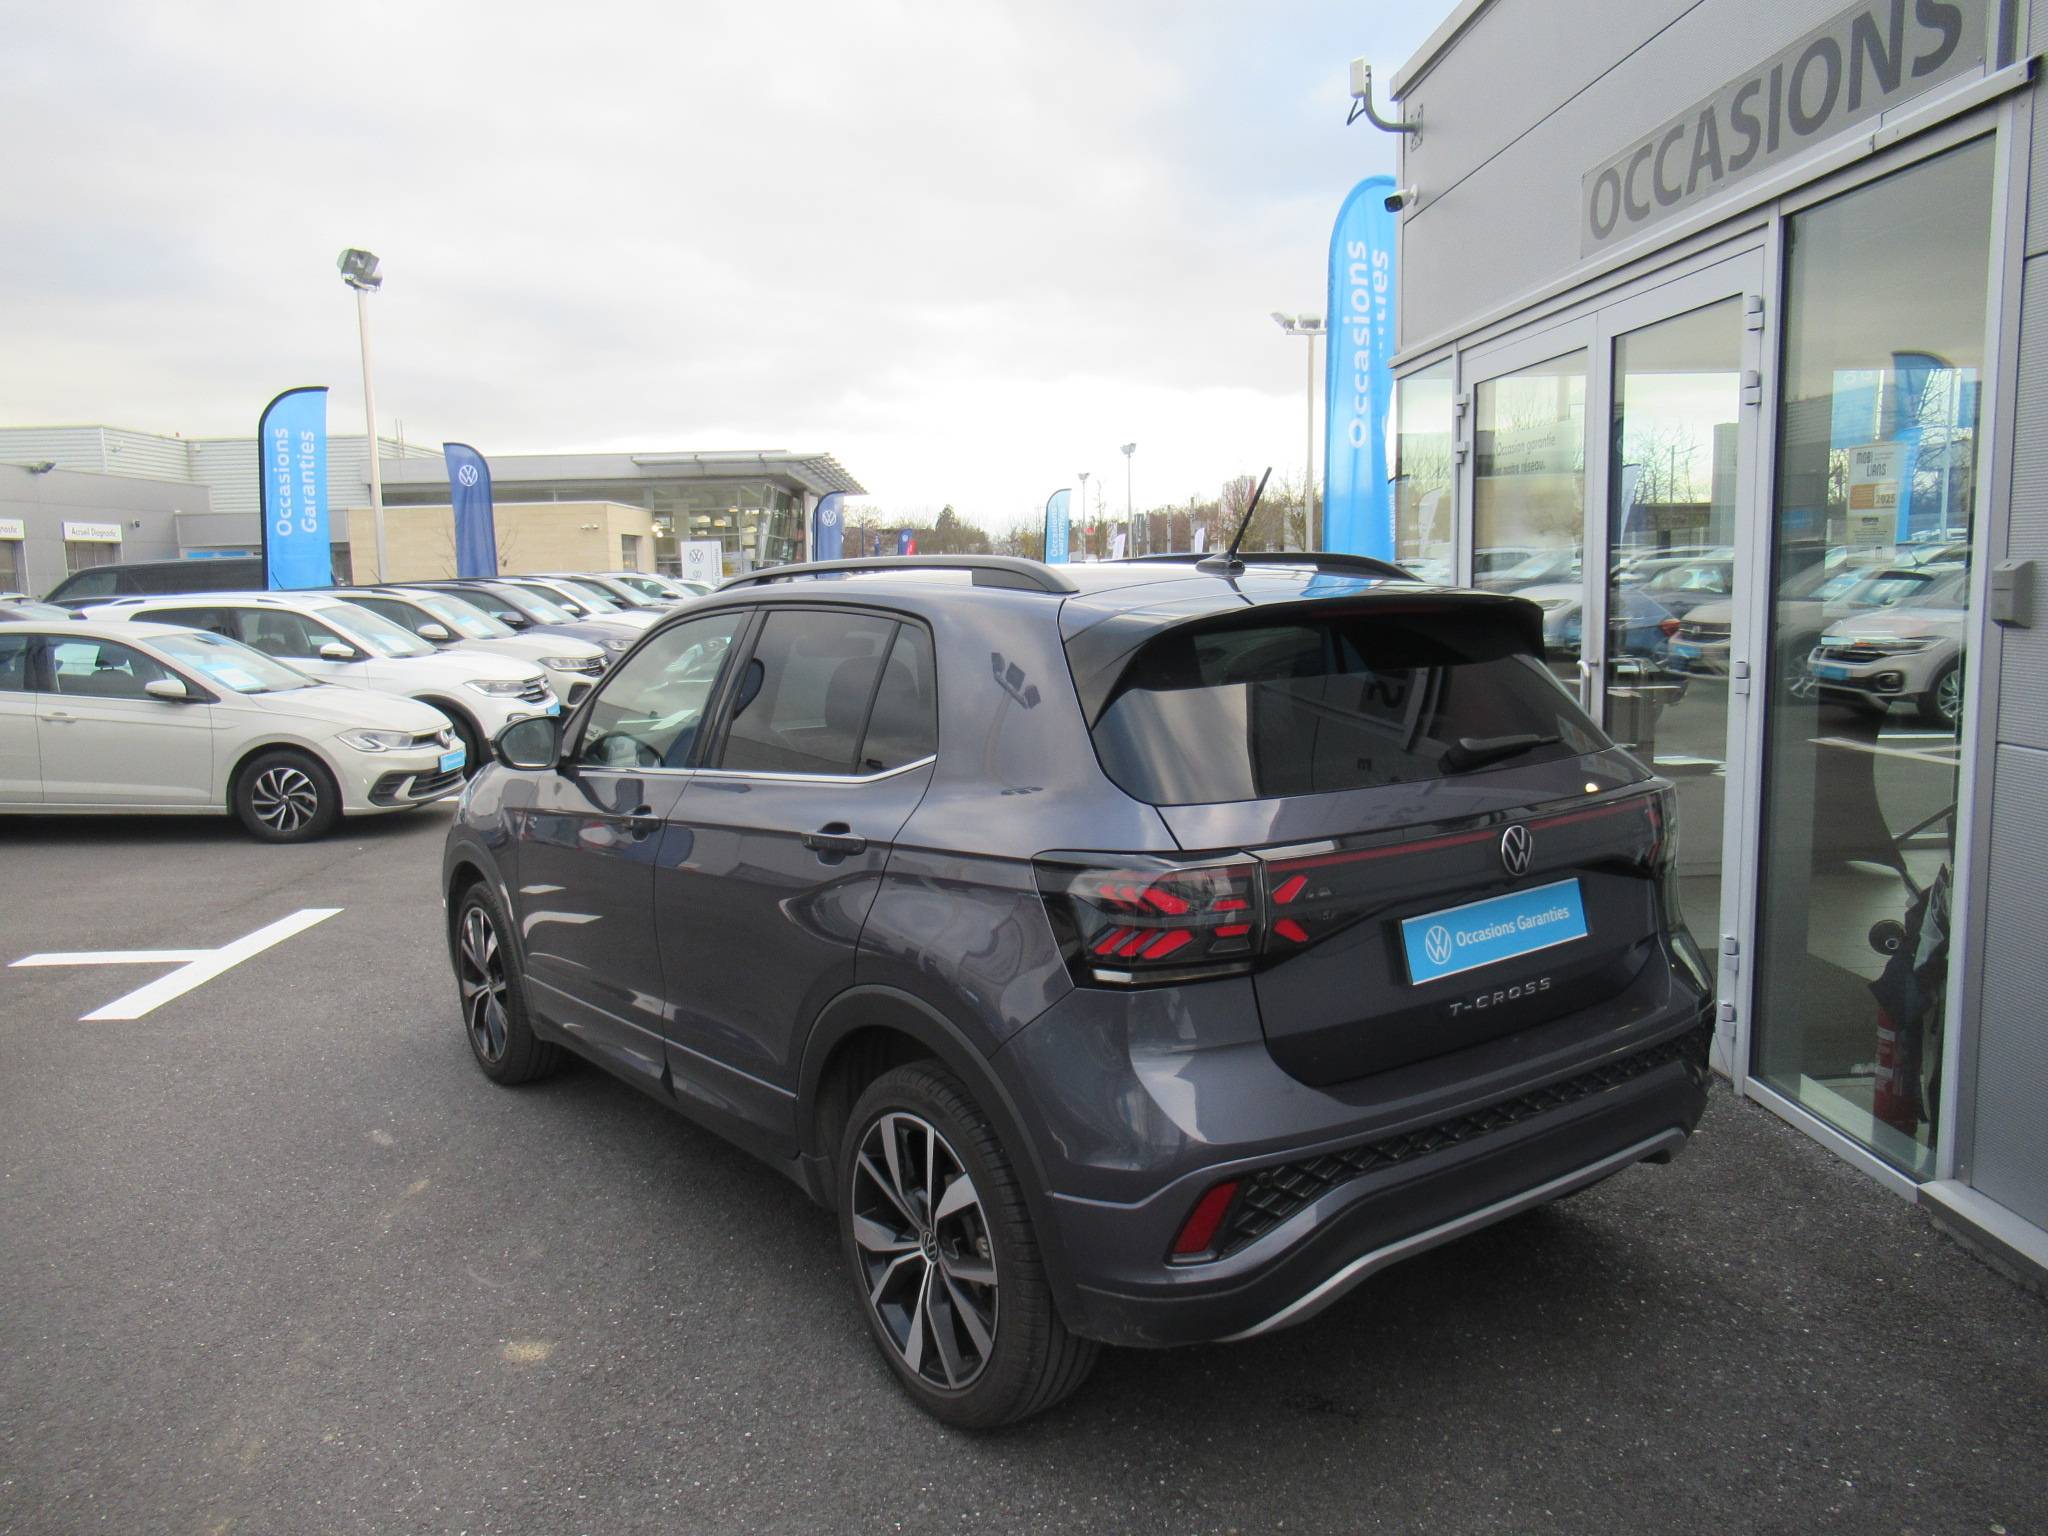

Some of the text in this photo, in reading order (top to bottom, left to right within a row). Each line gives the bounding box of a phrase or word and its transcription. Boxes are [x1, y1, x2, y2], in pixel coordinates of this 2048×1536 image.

[1590, 0, 1963, 241] OCCASIONS
[1343, 239, 1371, 449] Occasions
[273, 427, 293, 536] Occasions
[297, 430, 318, 533] Garanties
[1455, 918, 1516, 948] Occasions
[1516, 905, 1570, 935] Garanties
[1449, 977, 1552, 1017] T-CROSS
